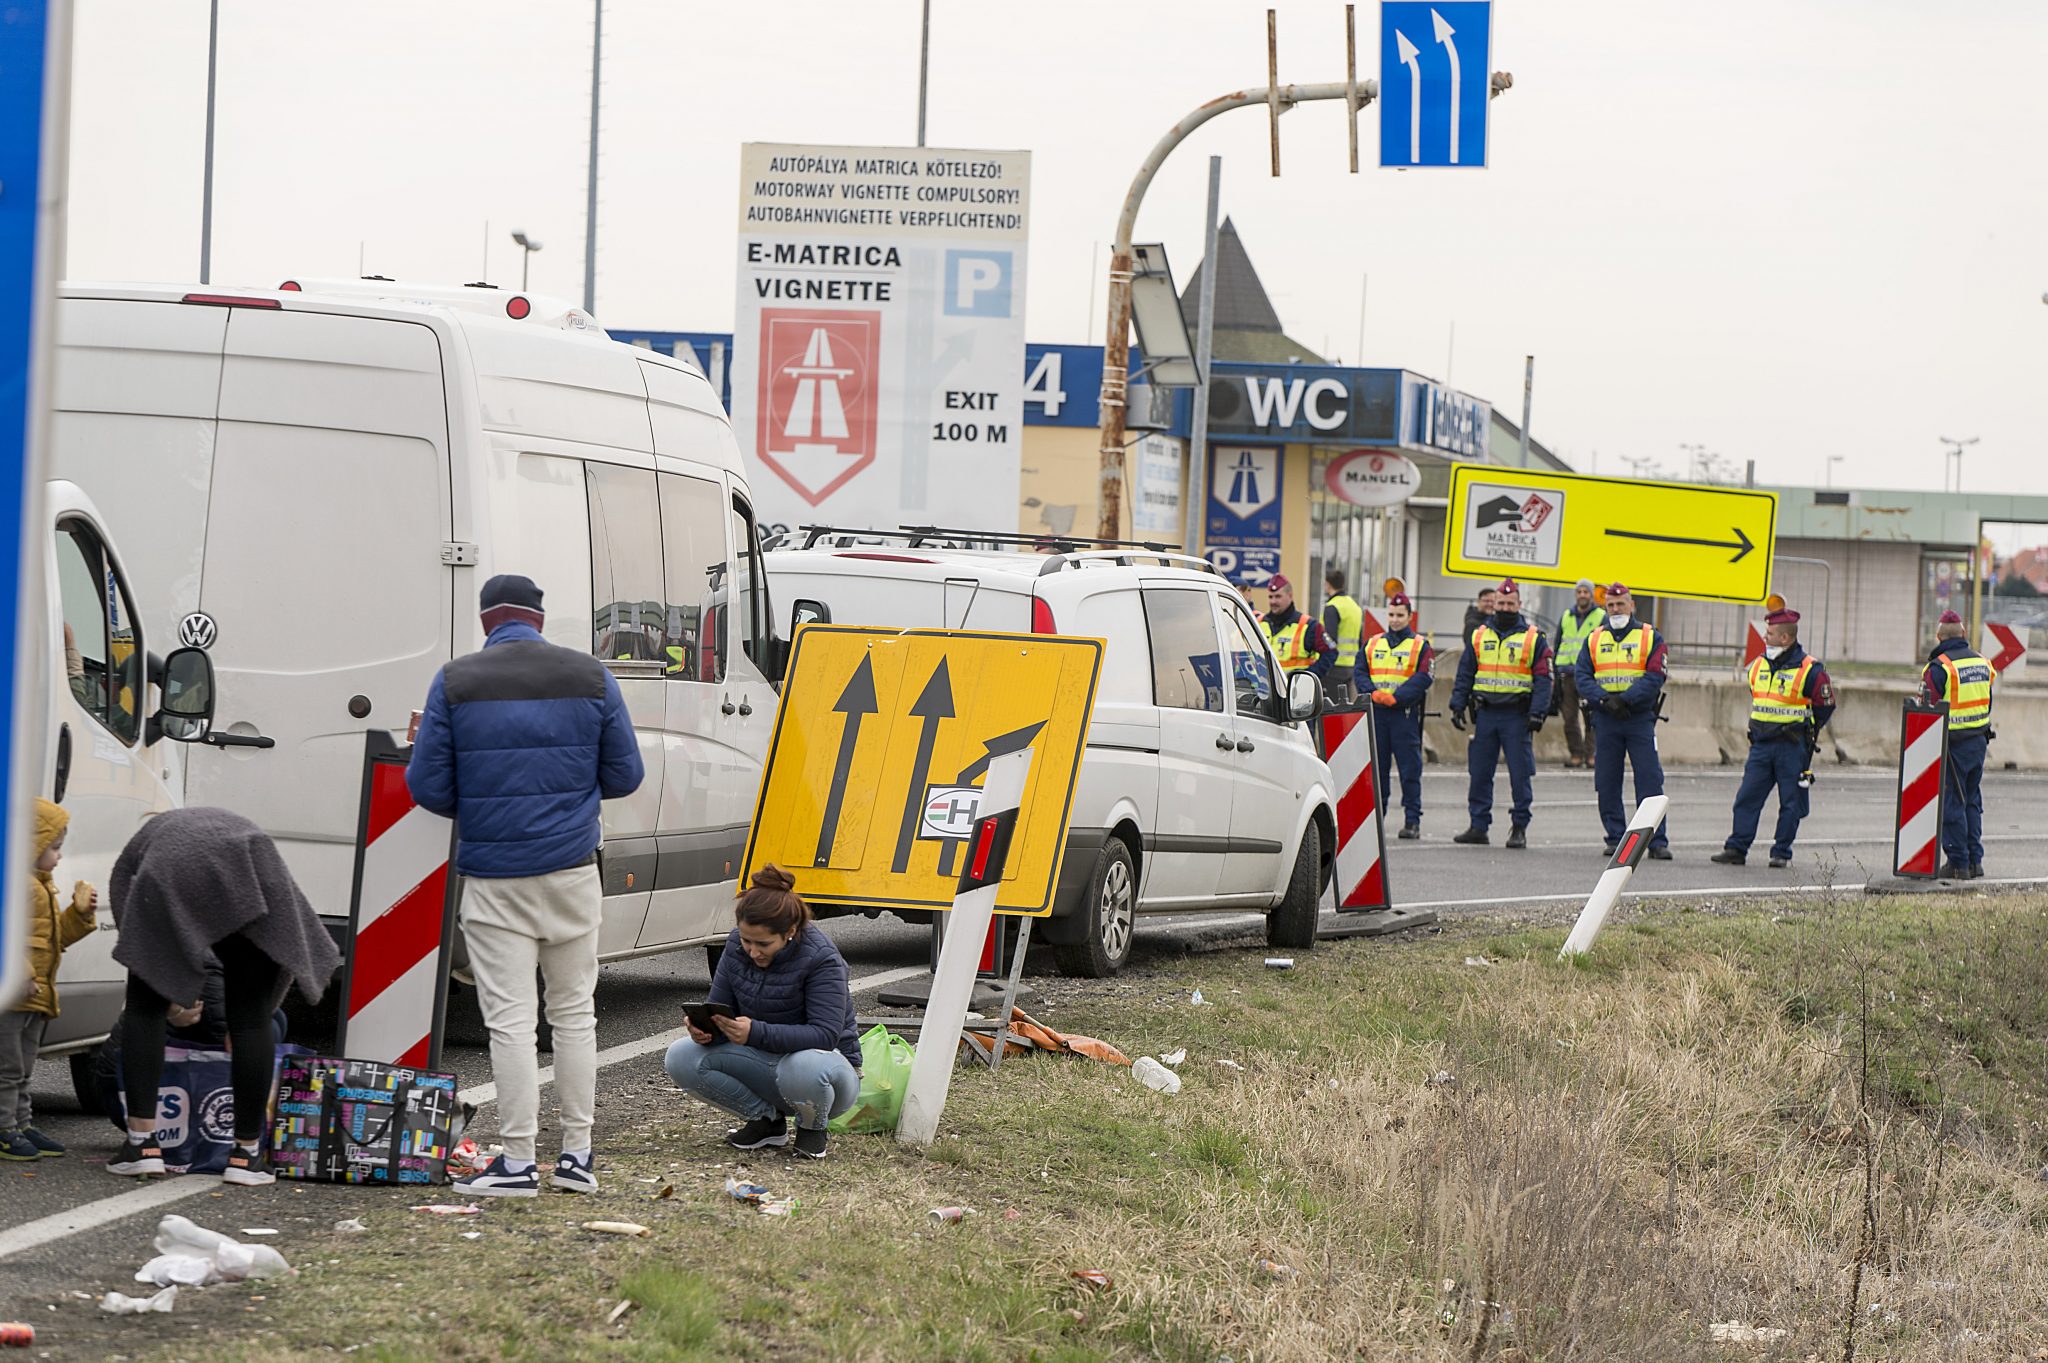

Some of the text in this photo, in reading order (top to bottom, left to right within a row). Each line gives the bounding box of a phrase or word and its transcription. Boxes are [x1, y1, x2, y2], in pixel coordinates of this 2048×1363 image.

[769, 155, 1002, 179] AUTÓPÁLYA MATRICA KÖTELEZŐ!
[754, 181, 1020, 204] MOTORWAY VIGNETTE COMPULSORY!
[747, 206, 1021, 229] AUTOBAHNVIGNETTE VERPFLICHTEND!
[747, 242, 902, 268] E-MATRICA
[755, 277, 892, 301] VIGNETTE
[957, 257, 1000, 309] P
[945, 391, 999, 411] EXIT
[1244, 376, 1348, 431] WC
[932, 422, 1007, 443] 100 M
[1345, 471, 1410, 486] MANUEL
[1487, 532, 1537, 546] MATRICA
[1486, 546, 1537, 561] VIGNETTE
[947, 799, 979, 825] H
